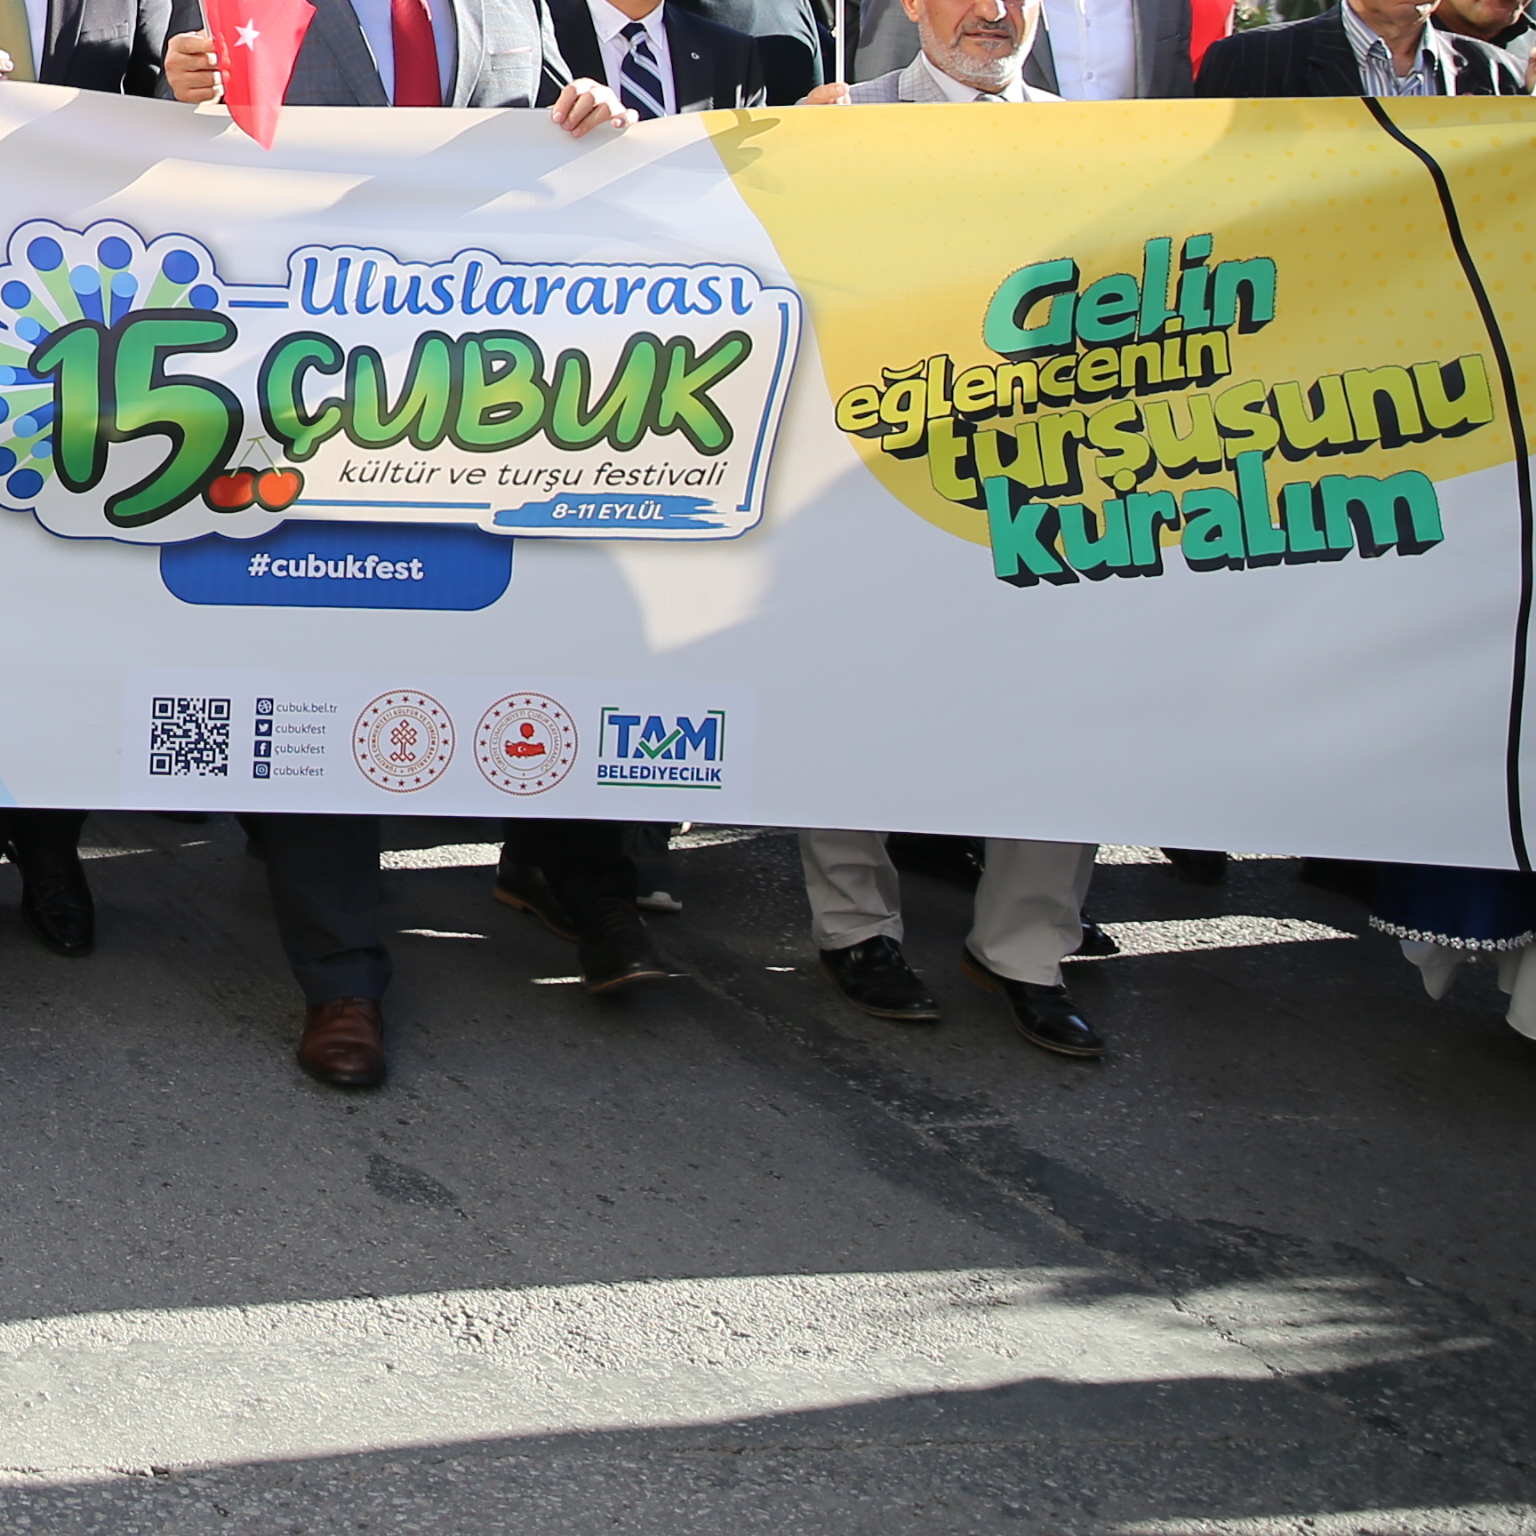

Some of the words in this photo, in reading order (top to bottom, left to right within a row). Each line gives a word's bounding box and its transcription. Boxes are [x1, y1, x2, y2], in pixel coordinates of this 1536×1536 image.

[300, 256, 753, 319] Uluslararası
[982, 233, 1277, 357] Gelin
[258, 330, 752, 462] ÇUBUK
[836, 316, 1231, 458] eğlencenin
[927, 353, 1494, 510] turşusunu
[338, 459, 442, 485] kültür
[449, 468, 487, 485] ve
[497, 463, 583, 492] turşu
[593, 460, 729, 487] festivali
[551, 502, 595, 520] 8-11
[598, 501, 665, 521] EYLÜL
[983, 450, 1444, 588] kuralım
[247, 553, 425, 582] #cubukfest
[276, 702, 338, 713] cubuk.bel.tr
[275, 724, 326, 734] cubukfest
[608, 714, 718, 761] TAM
[274, 744, 325, 756] çubukfest
[273, 765, 324, 776] cubukfest
